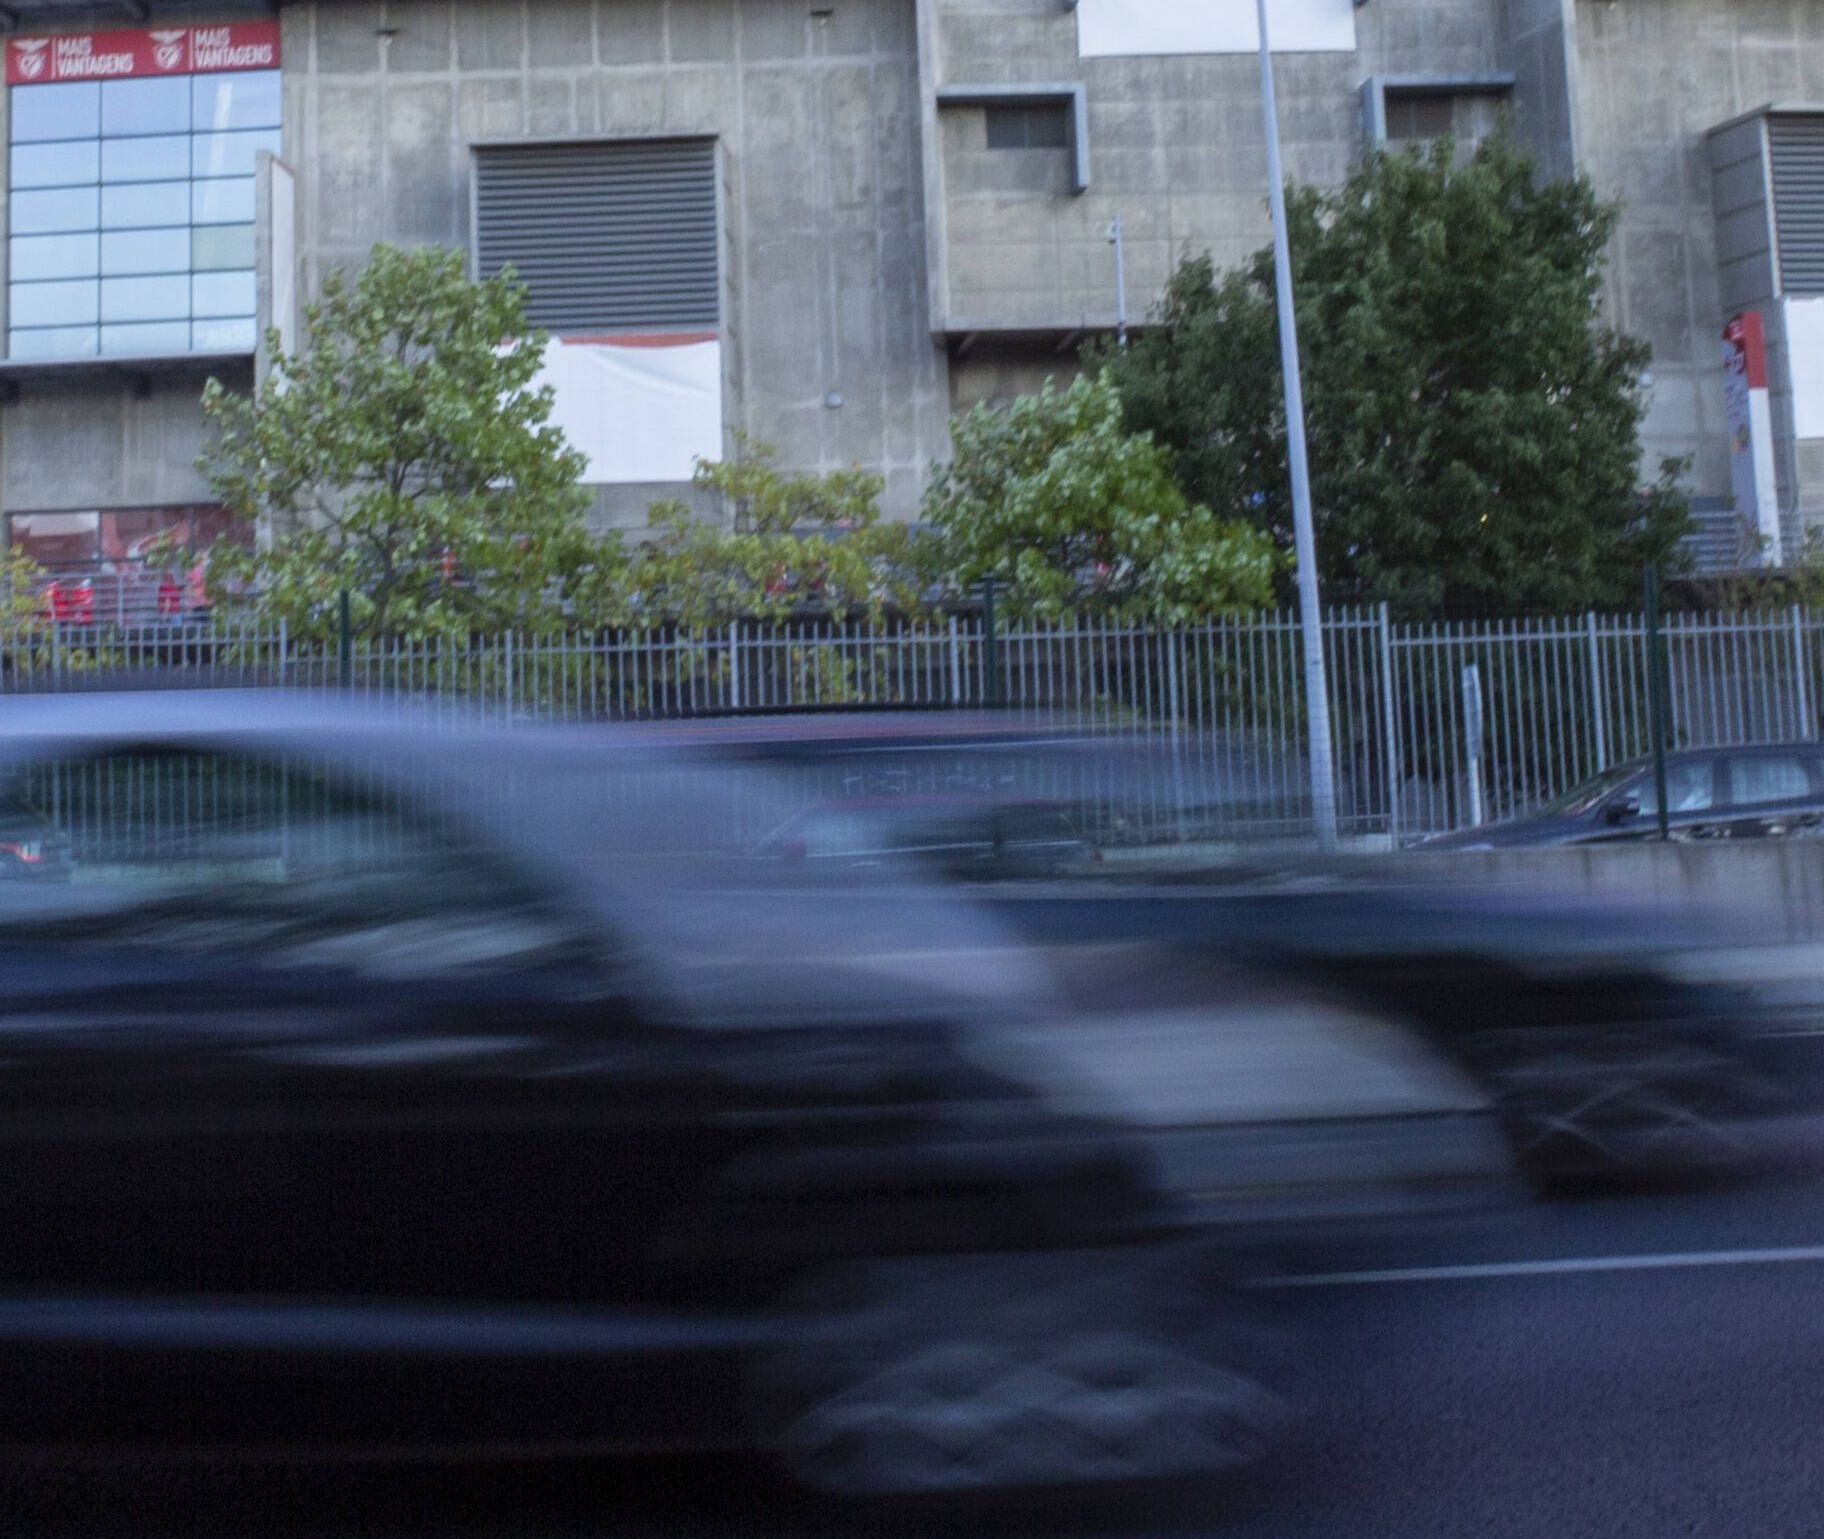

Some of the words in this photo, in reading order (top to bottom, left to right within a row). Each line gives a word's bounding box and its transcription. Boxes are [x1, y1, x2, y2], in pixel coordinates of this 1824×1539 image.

[58, 37, 92, 56] MAIS
[195, 27, 230, 47] MAIS
[58, 52, 134, 77] VANTAGENS
[194, 44, 272, 69] VANTAGENS
